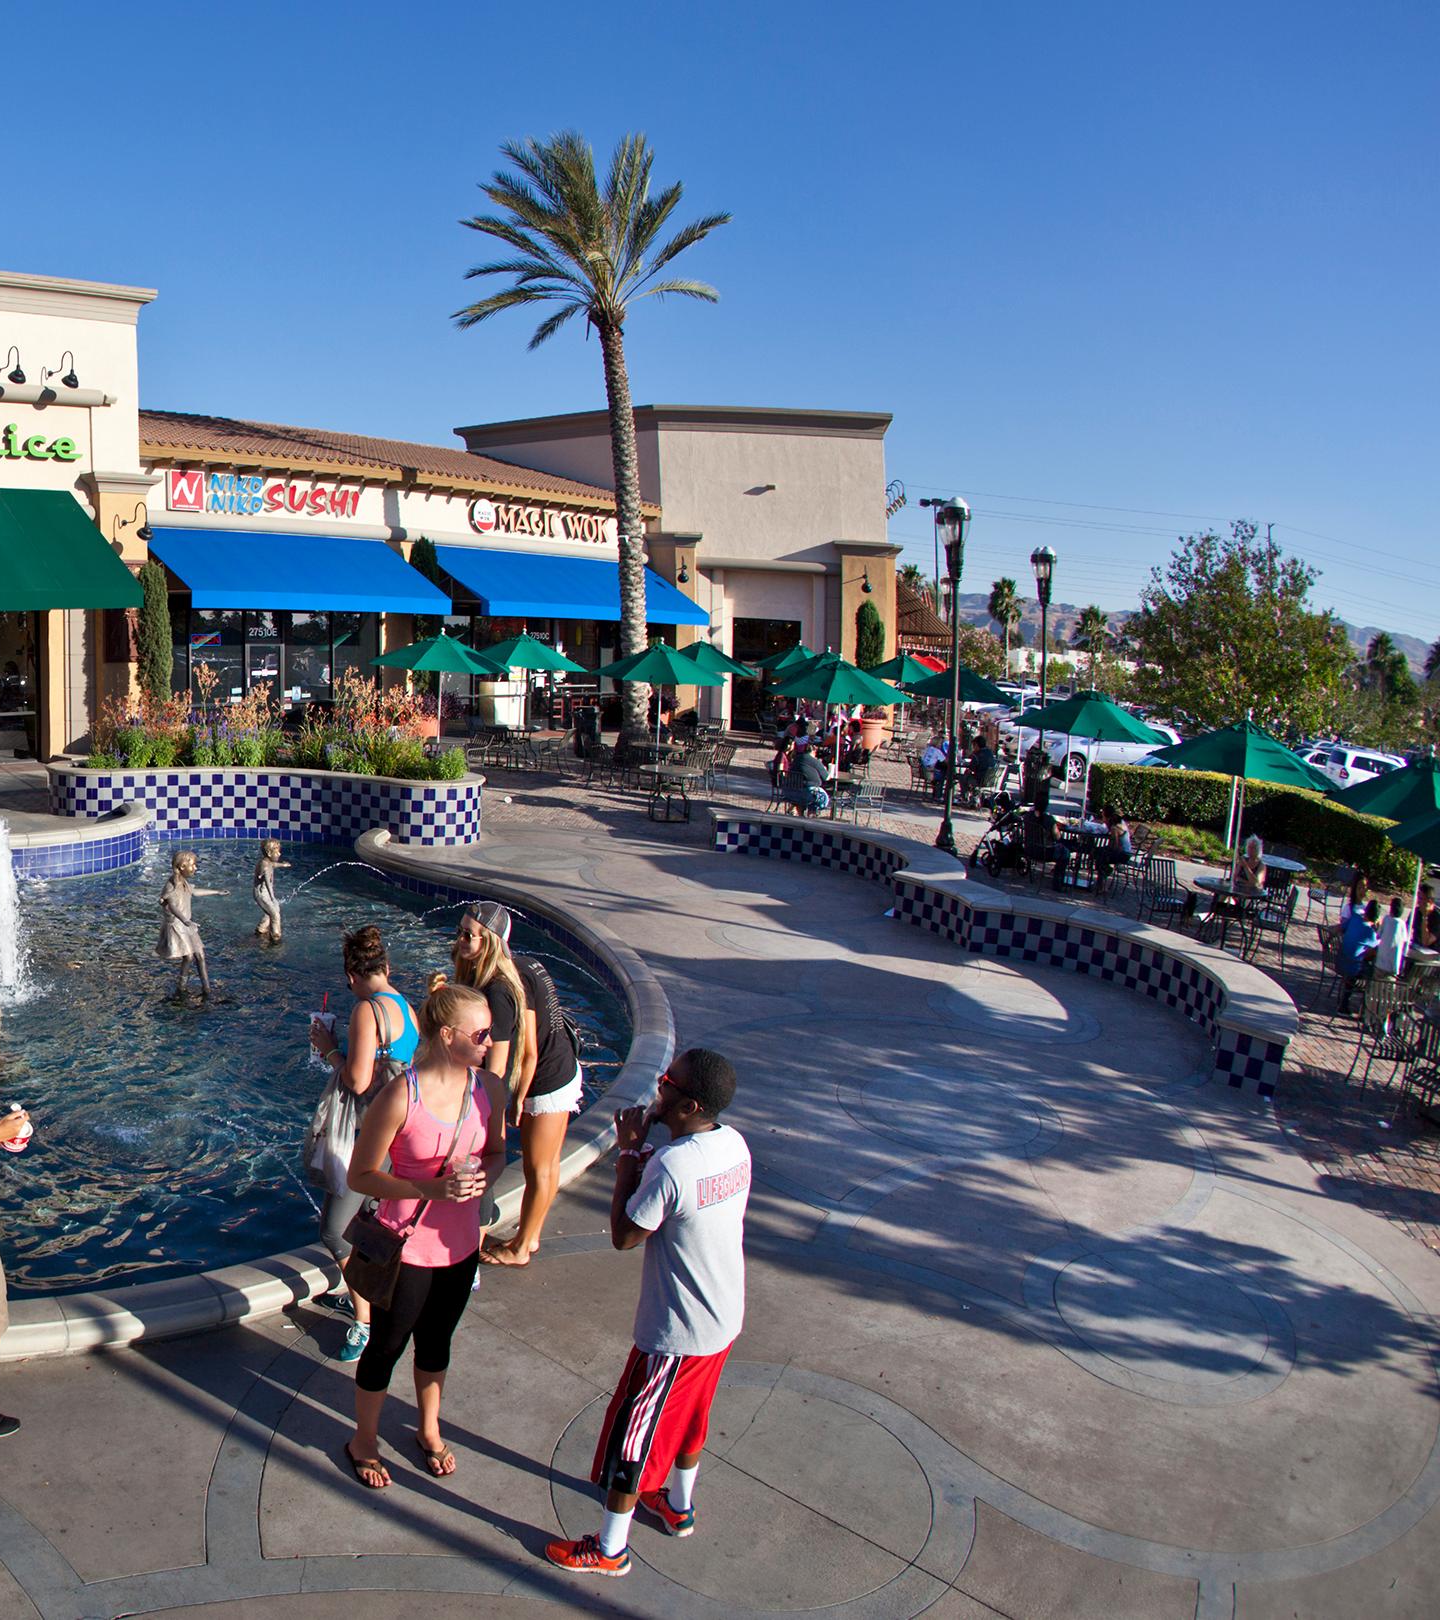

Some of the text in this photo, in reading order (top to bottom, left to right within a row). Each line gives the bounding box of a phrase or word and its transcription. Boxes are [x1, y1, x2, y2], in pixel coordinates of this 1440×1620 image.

[210, 474, 263, 494] NIKO
[210, 494, 262, 514] NIKO
[265, 483, 359, 517] SUSHI
[495, 504, 559, 538] MAGIC
[565, 514, 609, 543] WOK
[248, 627, 278, 637] 27510E
